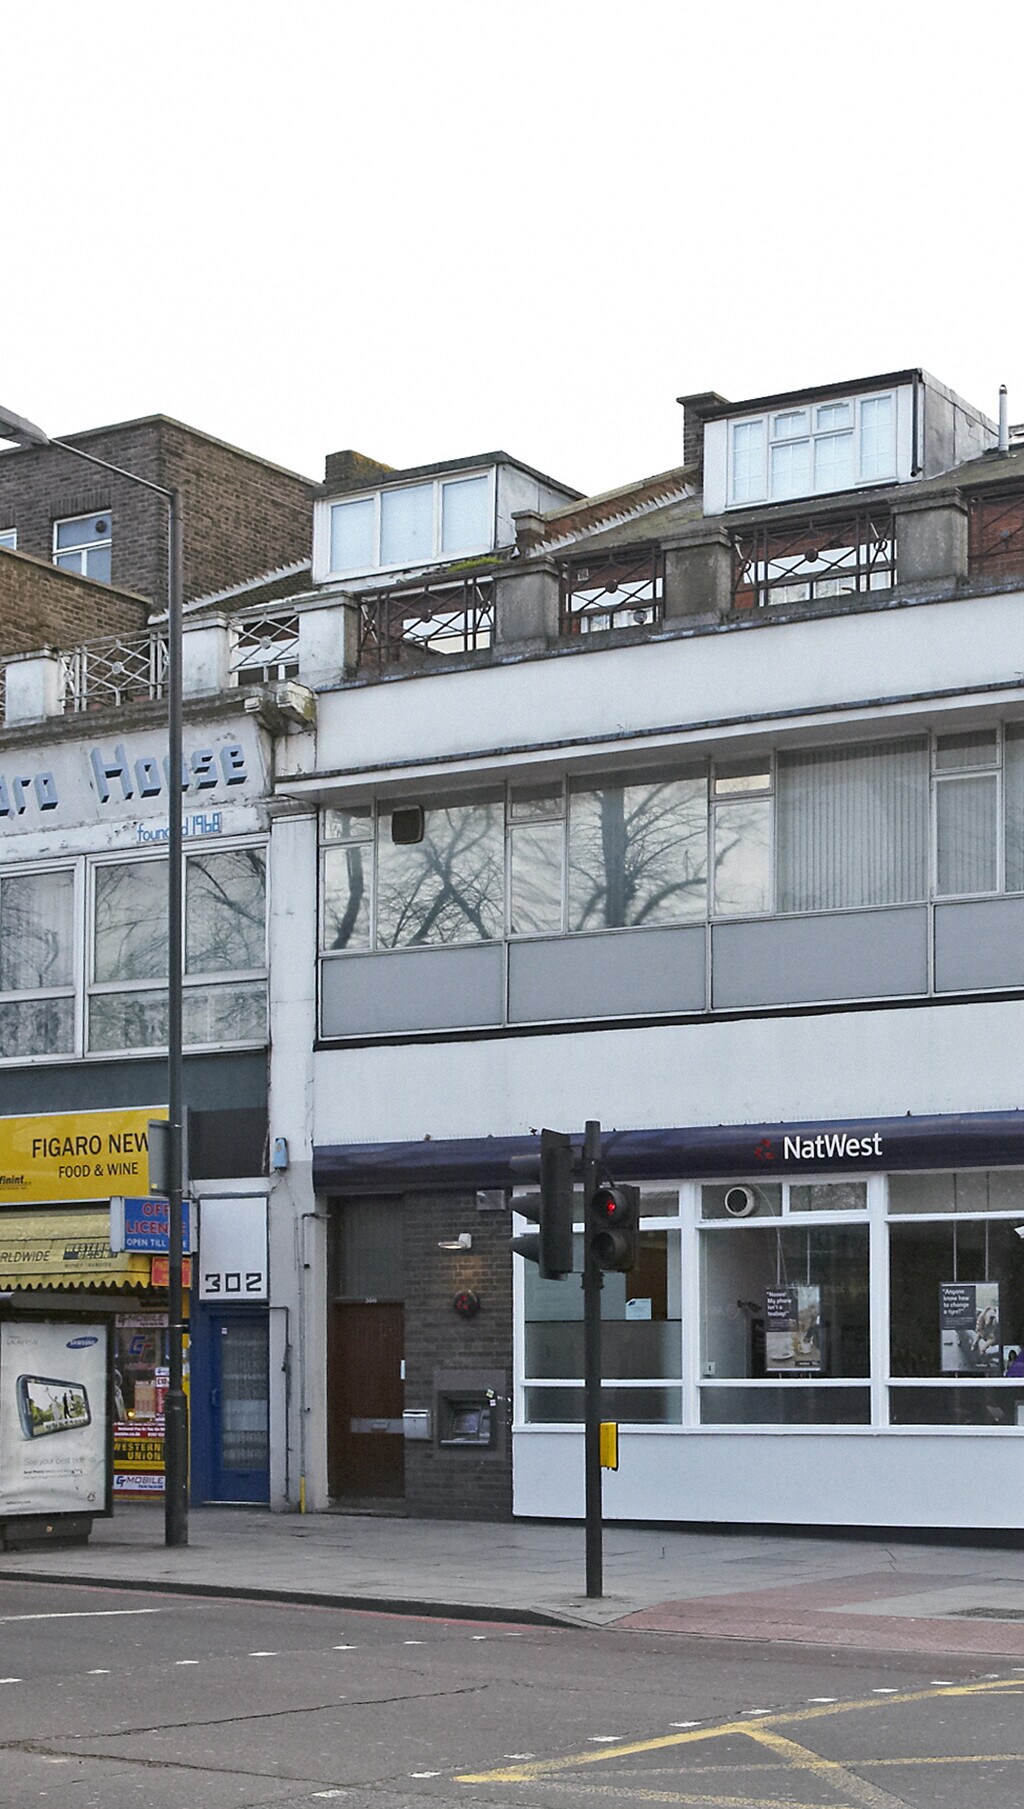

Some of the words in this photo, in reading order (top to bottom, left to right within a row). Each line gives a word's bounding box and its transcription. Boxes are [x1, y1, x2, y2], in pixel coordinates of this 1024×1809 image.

[137, 817, 188, 841] found
[193, 813, 220, 834] 1968
[32, 1135, 102, 1158] FIGARO
[784, 1132, 883, 1159] NatWest
[59, 1165, 91, 1178] FOOD
[94, 1164, 103, 1176] &
[107, 1162, 139, 1176] WINE
[126, 1221, 187, 1235] LICENE
[205, 1273, 262, 1293] 302
[114, 1443, 161, 1451] WESTERN
[127, 1452, 161, 1460] UNION
[127, 1476, 164, 1484] MOBILE
